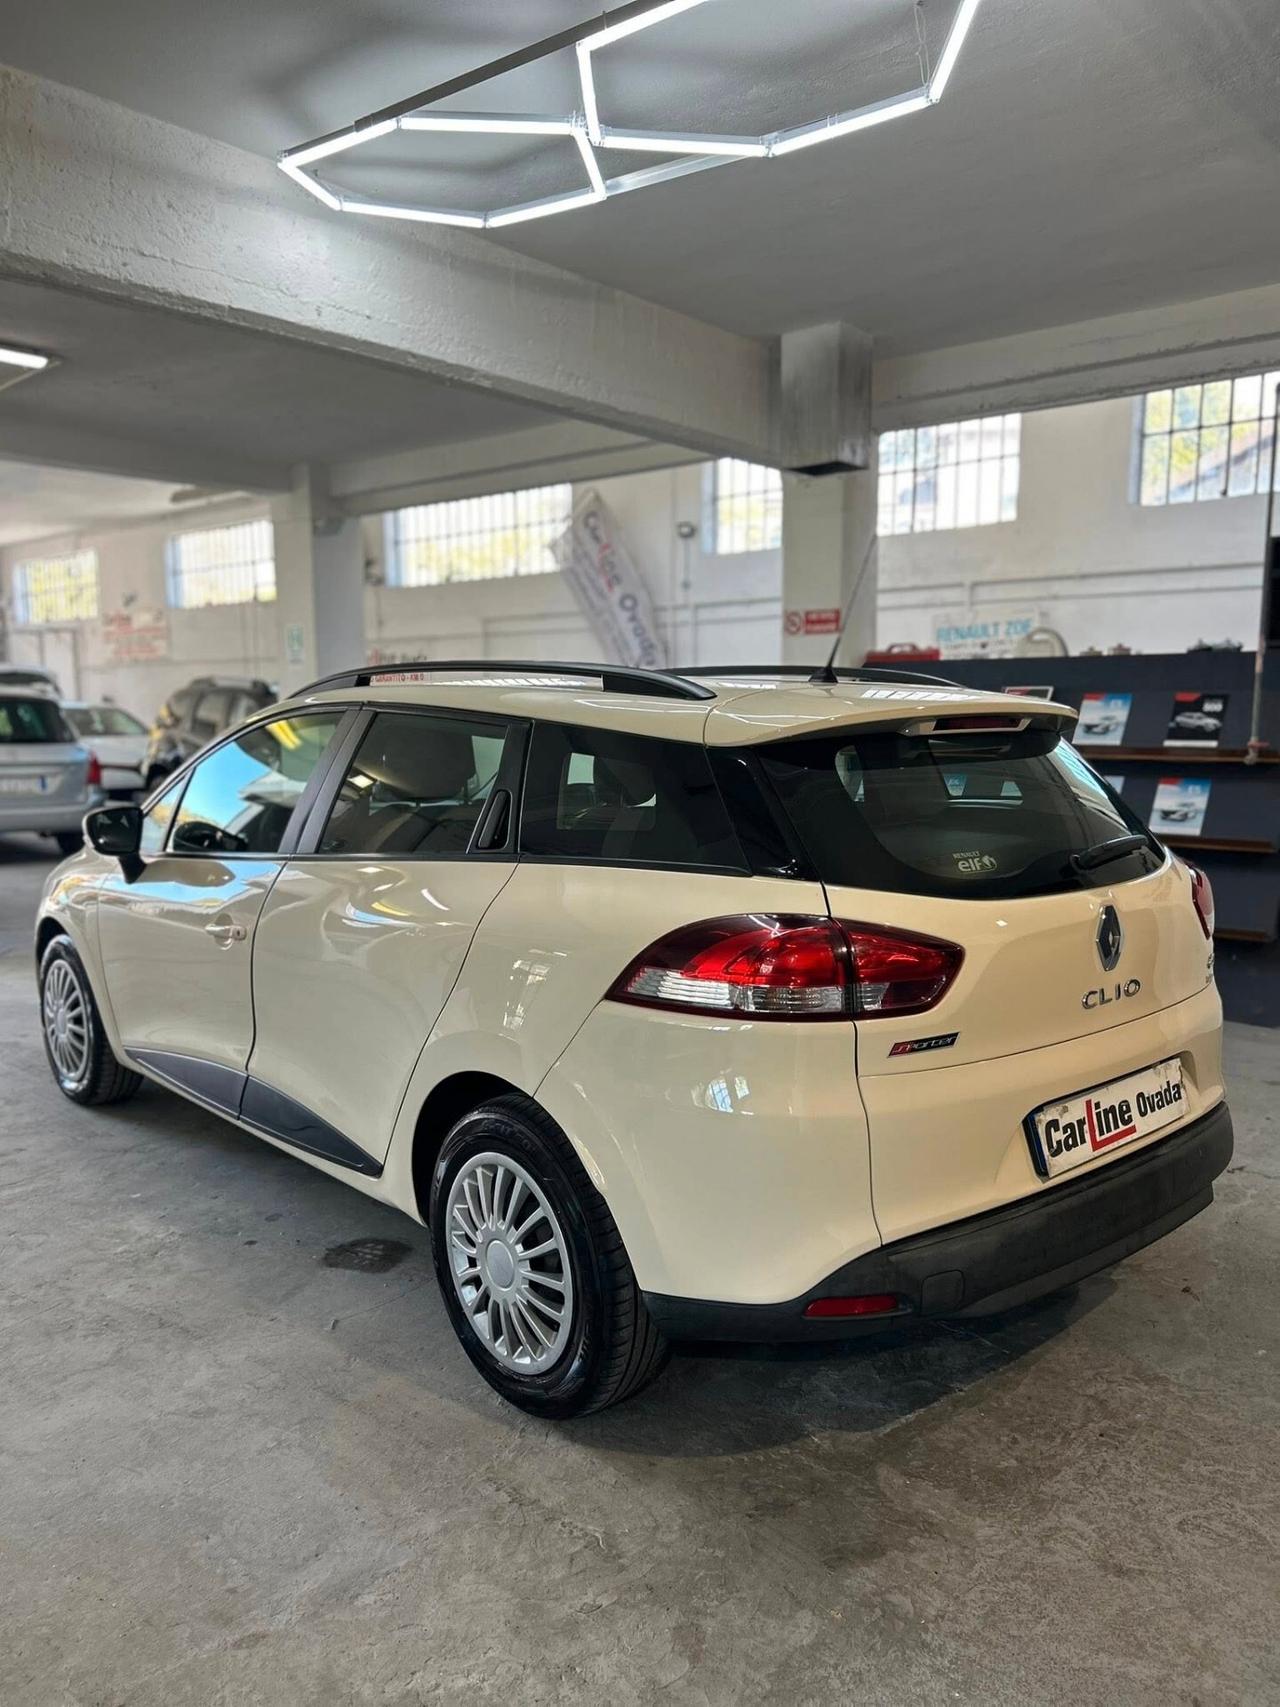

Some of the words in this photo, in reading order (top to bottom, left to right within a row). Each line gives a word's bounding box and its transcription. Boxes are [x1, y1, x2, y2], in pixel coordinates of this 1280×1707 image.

[958, 858, 982, 872] elf
[1081, 979, 1141, 1010] CLIO
[1045, 1098, 1137, 1158] CarLine
[1136, 1080, 1182, 1118] Ovada
